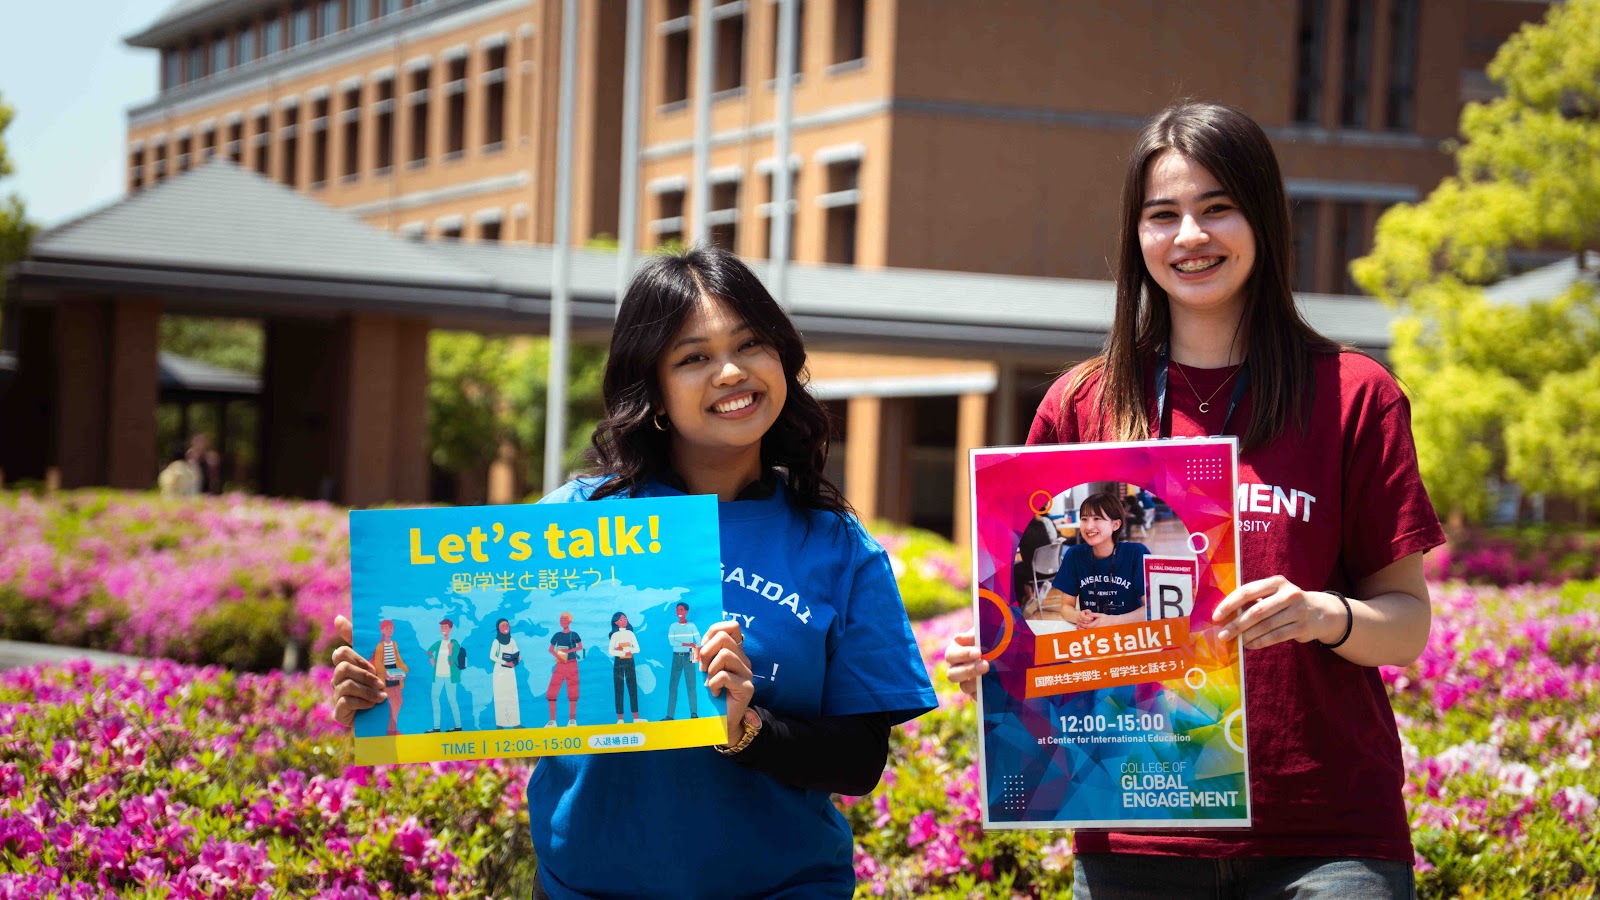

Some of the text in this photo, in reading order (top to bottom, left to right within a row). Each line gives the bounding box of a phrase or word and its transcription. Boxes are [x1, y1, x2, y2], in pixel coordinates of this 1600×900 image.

[409, 514, 661, 565] Let's talk!
[1079, 574, 1102, 589] ANSAI
[720, 562, 813, 625] AIDAI
[1159, 584, 1185, 619] B
[1052, 633, 1111, 660] Let's
[441, 742, 475, 755] TIME
[495, 737, 582, 753] 12:00-15:00
[1037, 733, 1191, 745] at Center for International Education
[1120, 761, 1187, 773] COLLEGE OF
[1121, 774, 1188, 790] GLOBAL
[1122, 791, 1239, 808] ENGAGEMENT
